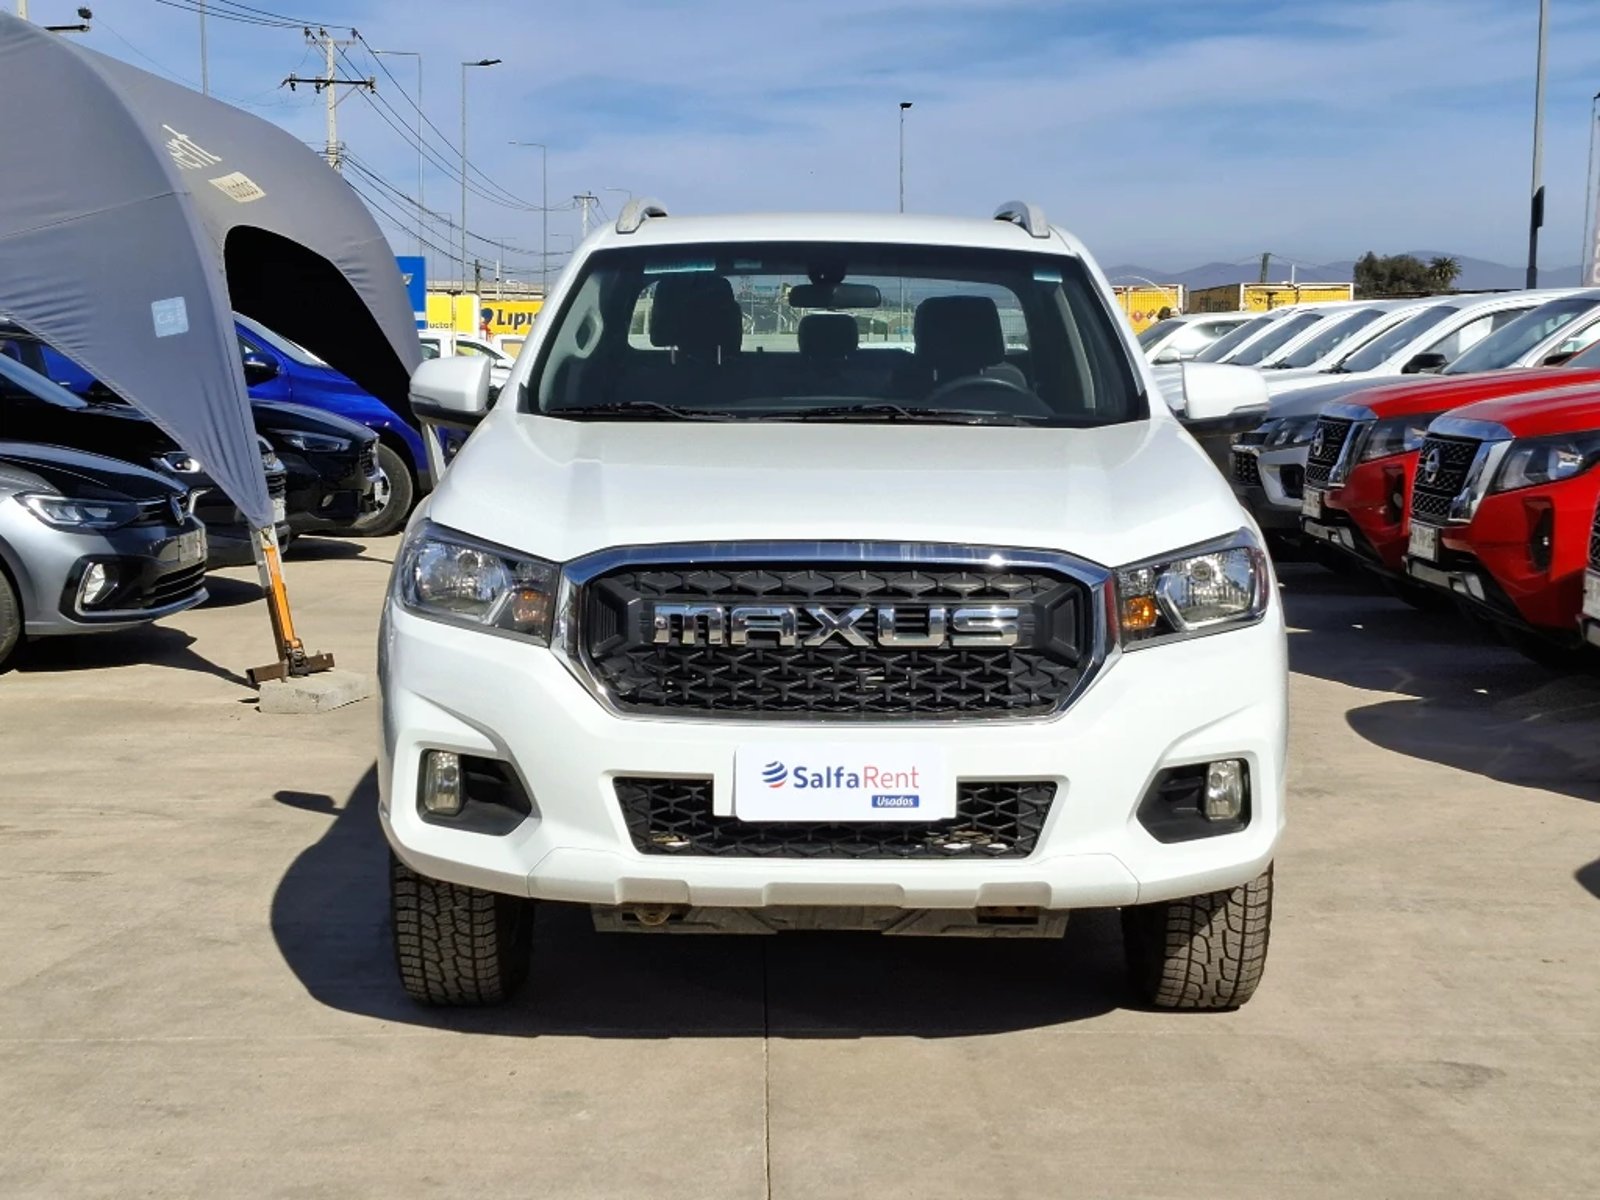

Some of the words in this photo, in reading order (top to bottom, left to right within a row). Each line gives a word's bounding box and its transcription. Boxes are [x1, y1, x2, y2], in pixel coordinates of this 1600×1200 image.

[497, 309, 538, 330] Lipi
[653, 604, 1020, 647] MAXUS
[793, 766, 920, 789] SalfaRent
[877, 796, 915, 806] Usados
